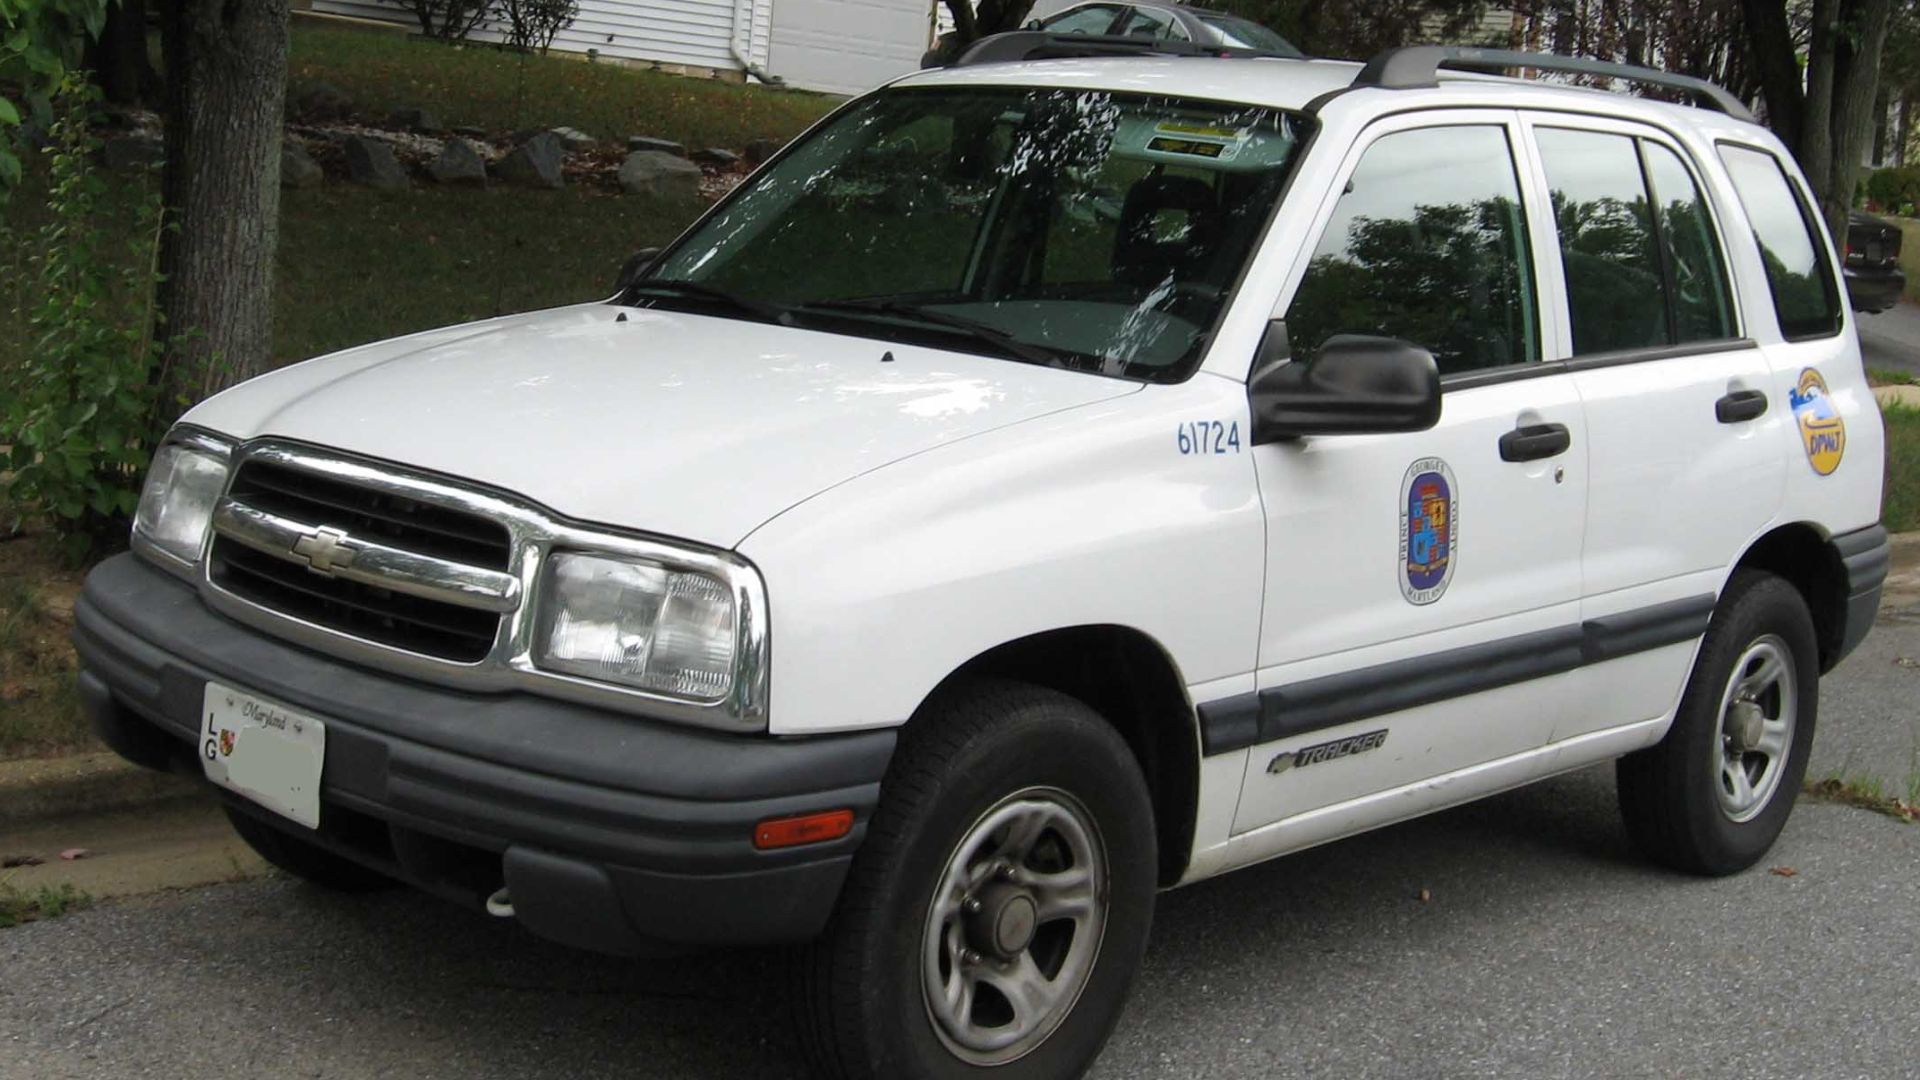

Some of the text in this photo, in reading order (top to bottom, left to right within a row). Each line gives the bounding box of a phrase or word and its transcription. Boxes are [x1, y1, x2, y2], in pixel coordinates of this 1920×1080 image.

[1178, 420, 1240, 455] 61724
[241, 701, 287, 731] Maryland
[1298, 731, 1388, 767] TRACKER
